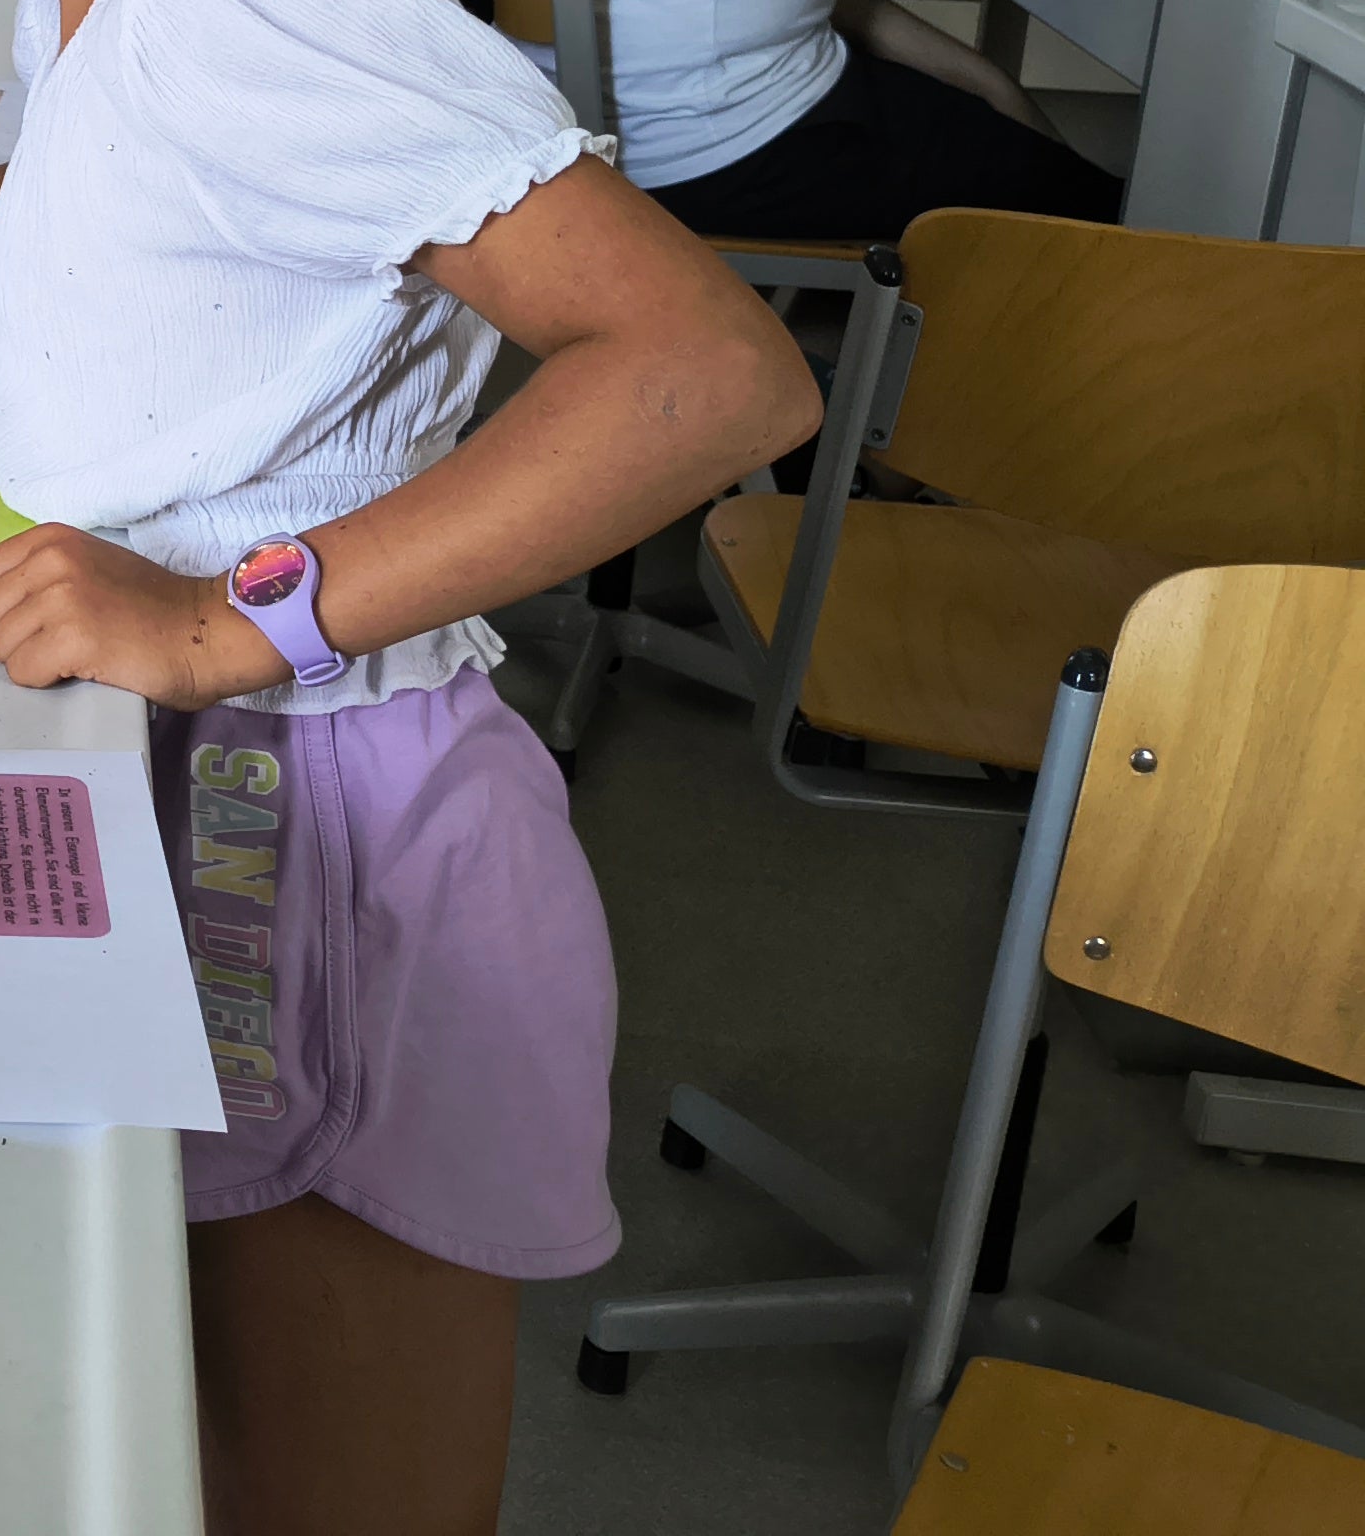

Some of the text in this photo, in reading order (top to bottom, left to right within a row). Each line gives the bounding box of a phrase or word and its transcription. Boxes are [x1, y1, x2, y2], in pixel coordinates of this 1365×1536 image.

[58, 788, 71, 796] In
[20, 844, 33, 856] Sie
[64, 836, 84, 875] Eisennagel
[45, 859, 59, 871] Sie
[22, 859, 35, 889] schauen
[47, 874, 62, 890] sind
[71, 881, 86, 897] sind
[2, 897, 14, 906] ist
[26, 893, 41, 913] nicht
[50, 892, 63, 906] alle
[4, 909, 17, 924] der
[52, 908, 64, 925] wirr
[75, 902, 90, 926] kleine
[188, 744, 286, 1120] SAN DIEGO
